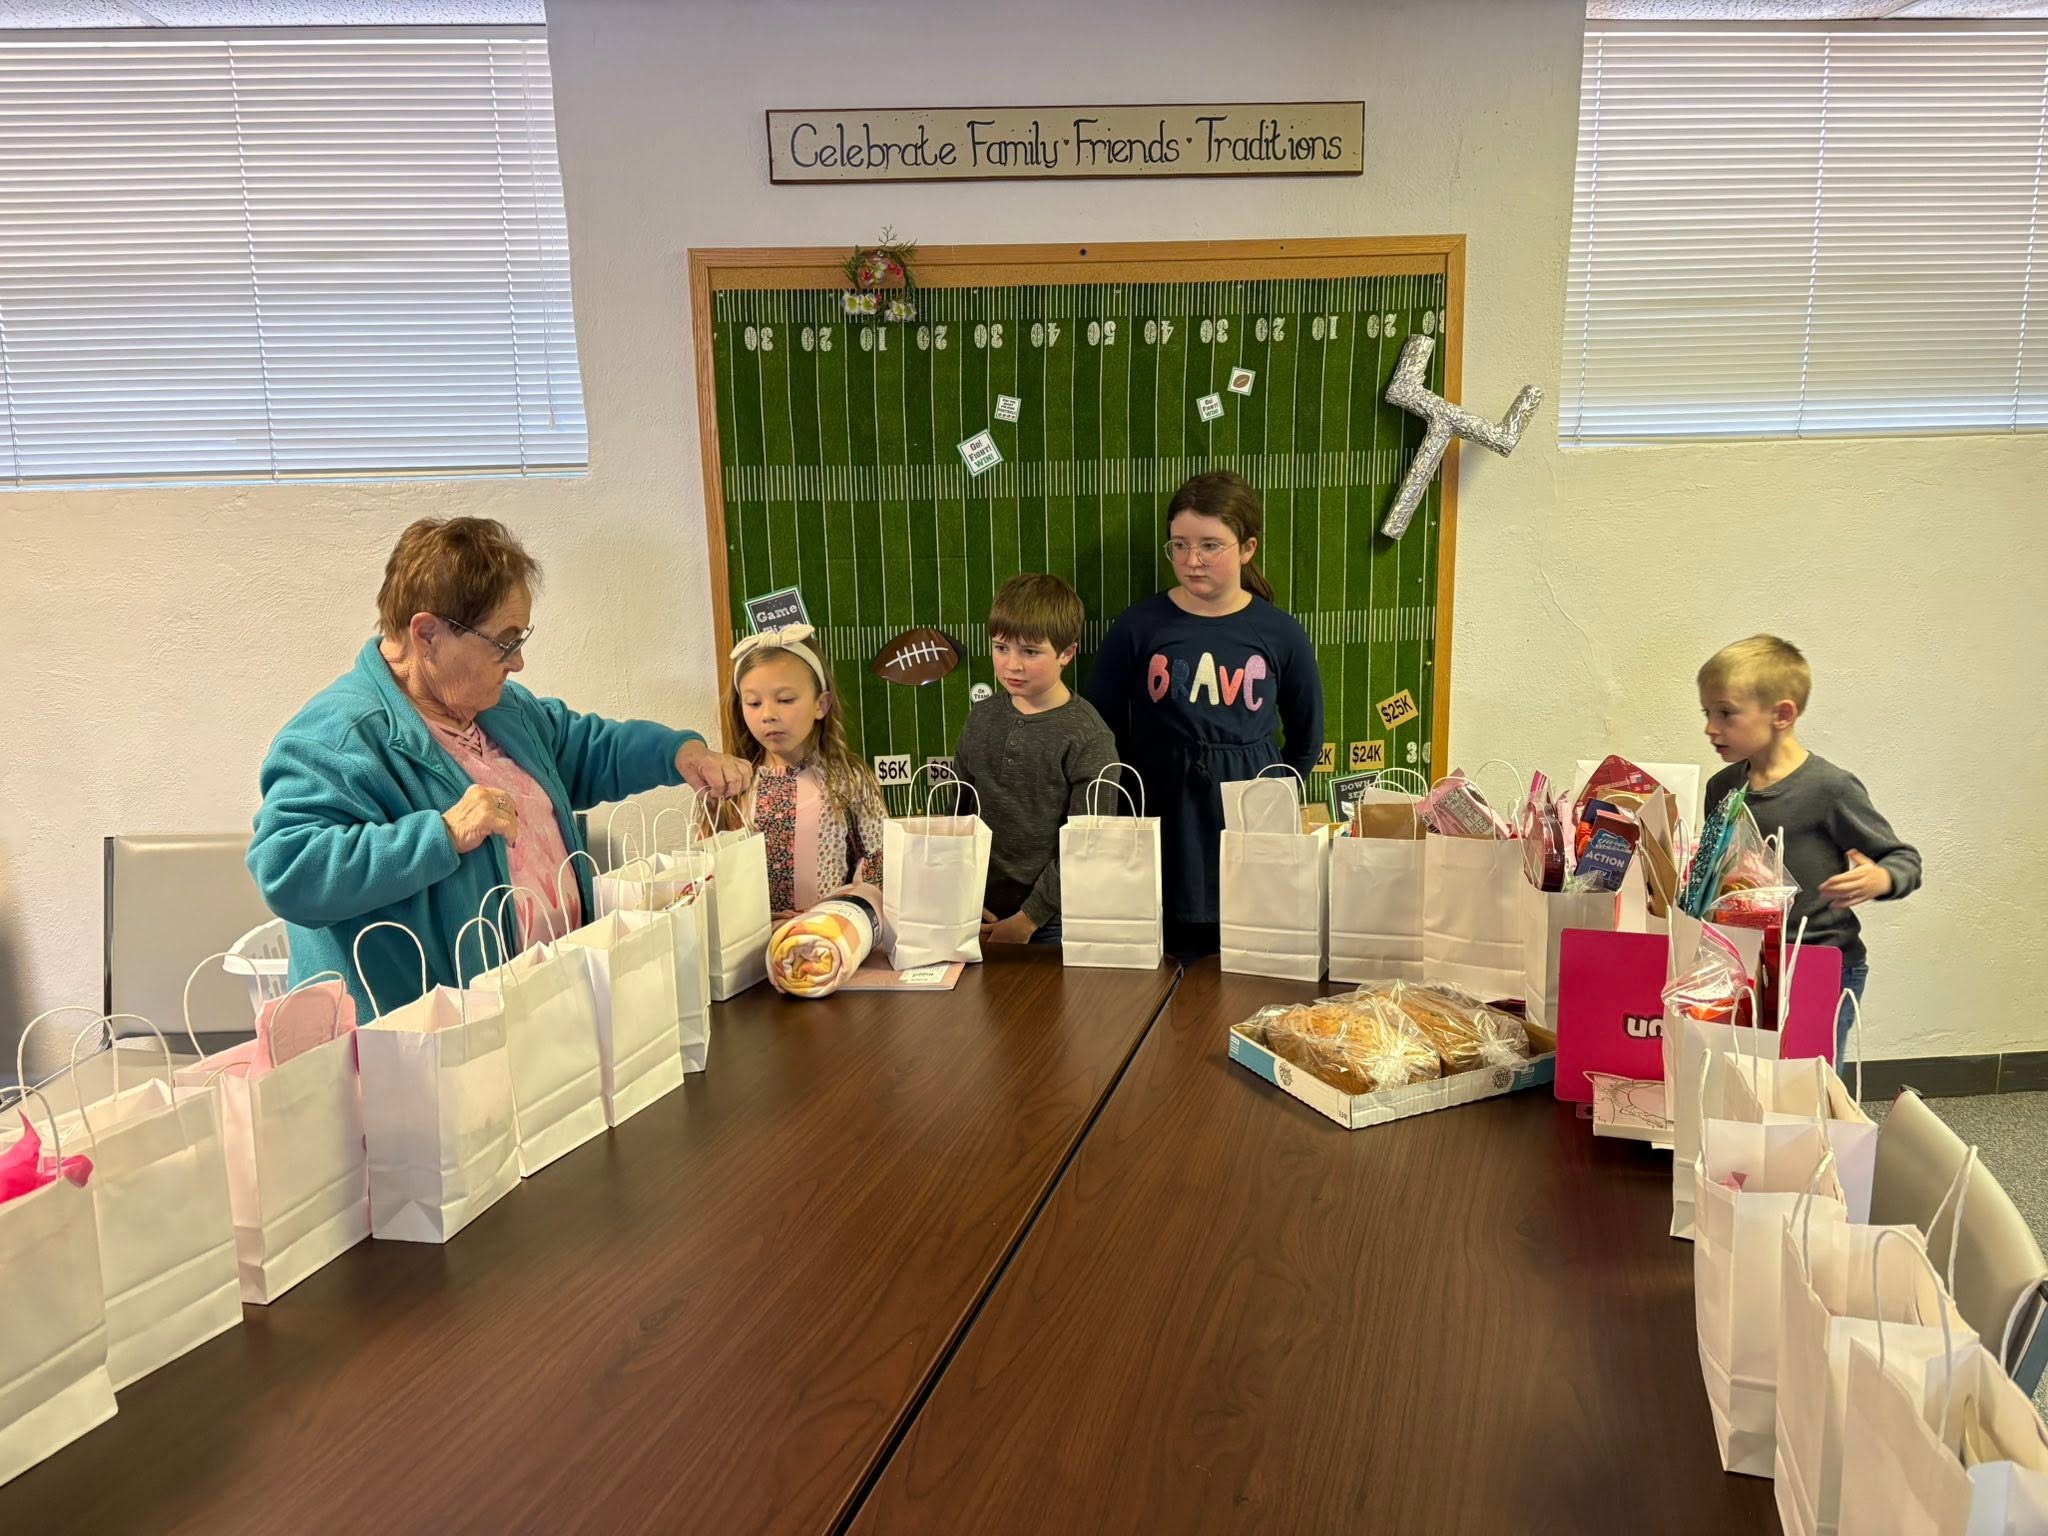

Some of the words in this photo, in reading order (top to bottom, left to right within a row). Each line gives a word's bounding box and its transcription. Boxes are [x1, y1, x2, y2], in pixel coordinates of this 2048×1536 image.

[791, 123, 956, 169] Celebrate
[967, 120, 1058, 168] Family
[1073, 118, 1180, 166] Friends
[1195, 115, 1342, 163] Traditions
[756, 604, 798, 623] Game
[1381, 694, 1413, 724] $25K
[1352, 744, 1382, 765] $24K
[878, 760, 909, 782] $6K
[1585, 850, 1625, 868] ACTION
